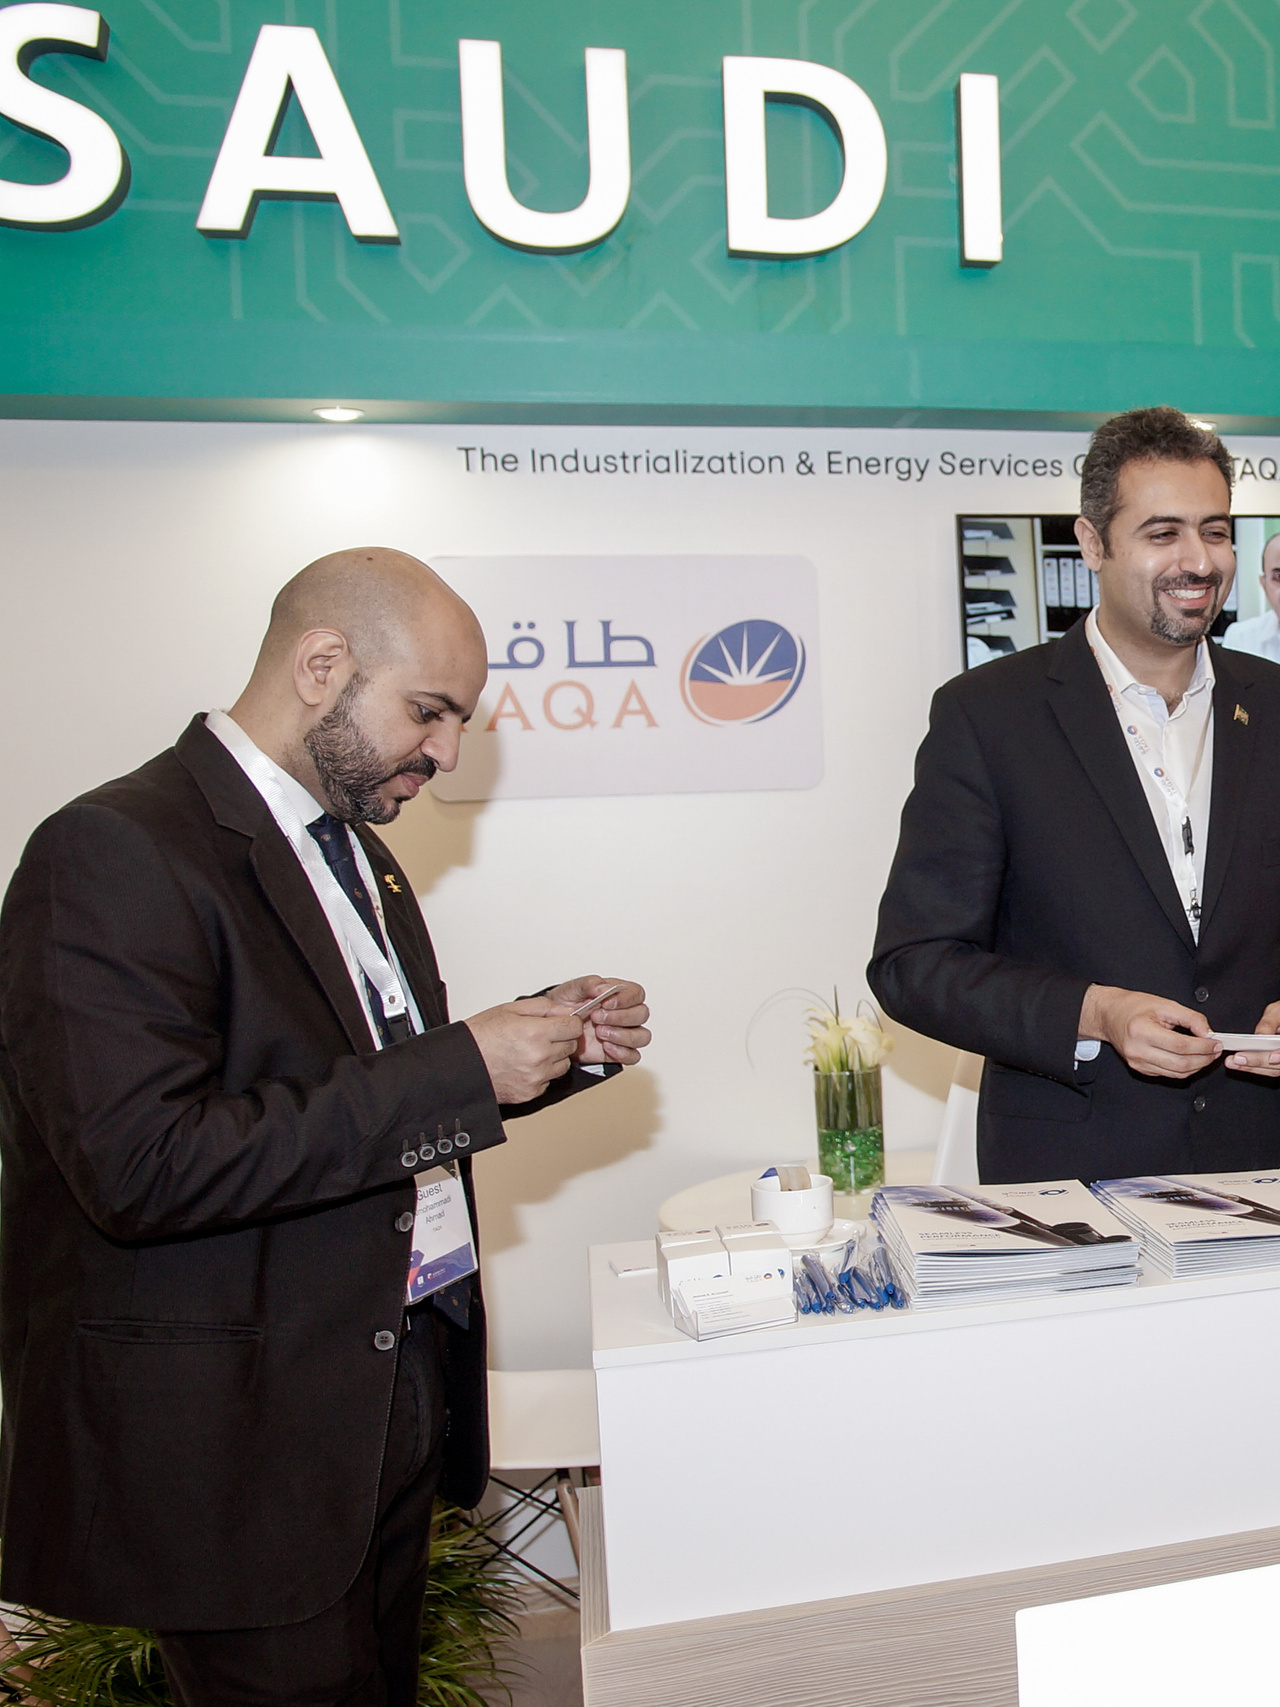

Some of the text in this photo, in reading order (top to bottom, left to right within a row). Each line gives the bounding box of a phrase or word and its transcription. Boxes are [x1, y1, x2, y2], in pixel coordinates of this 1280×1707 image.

[0, 2, 1003, 266] SAUDI
[457, 446, 519, 473] The
[531, 448, 785, 475] Industrialization
[796, 451, 815, 475] &
[827, 451, 929, 483] Energy
[939, 452, 1064, 478] Services
[461, 679, 661, 732] AQA
